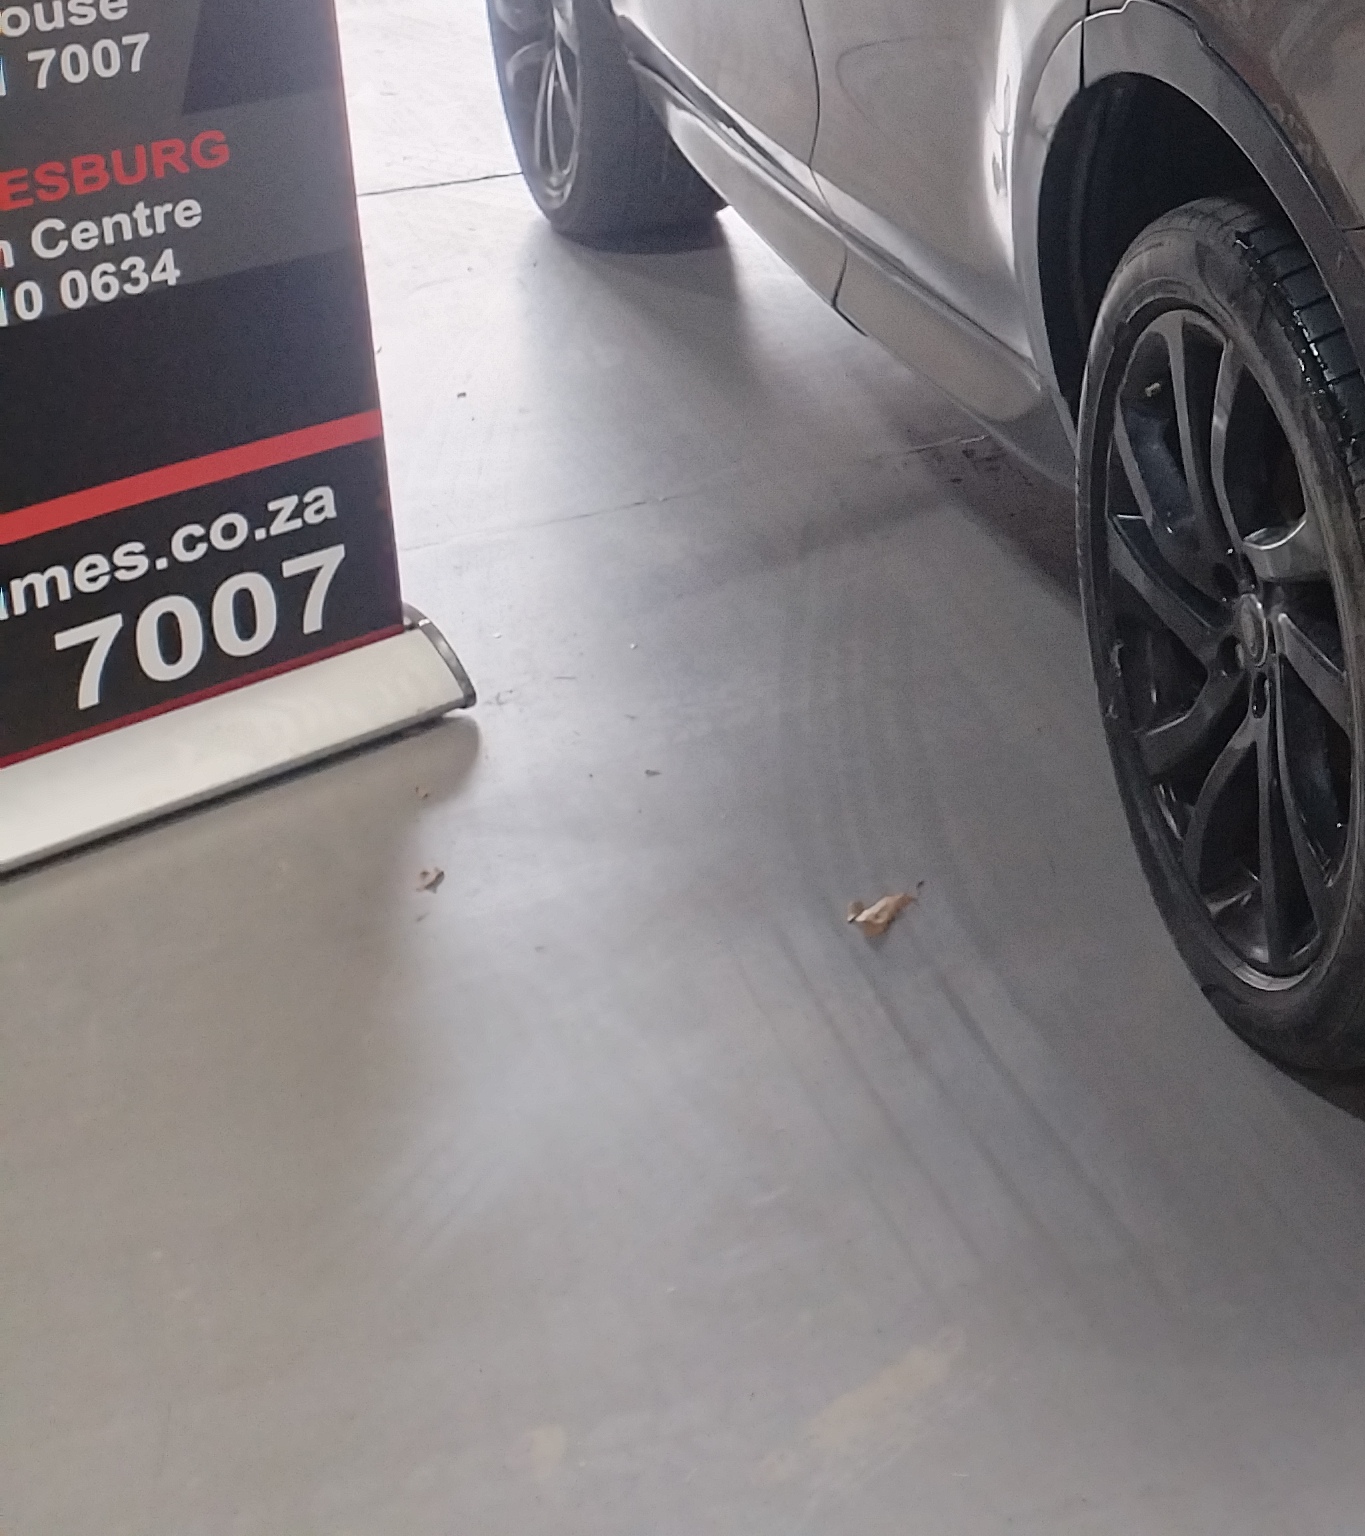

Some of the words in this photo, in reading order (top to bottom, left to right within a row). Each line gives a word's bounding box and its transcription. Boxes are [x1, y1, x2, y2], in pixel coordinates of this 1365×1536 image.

[27, 32, 150, 90] 7007
[0, 130, 230, 211] ESBURG
[31, 199, 202, 259] Centre
[60, 248, 180, 309] 0634
[0, 485, 337, 620] mes.co.za
[54, 543, 345, 710] 7007
